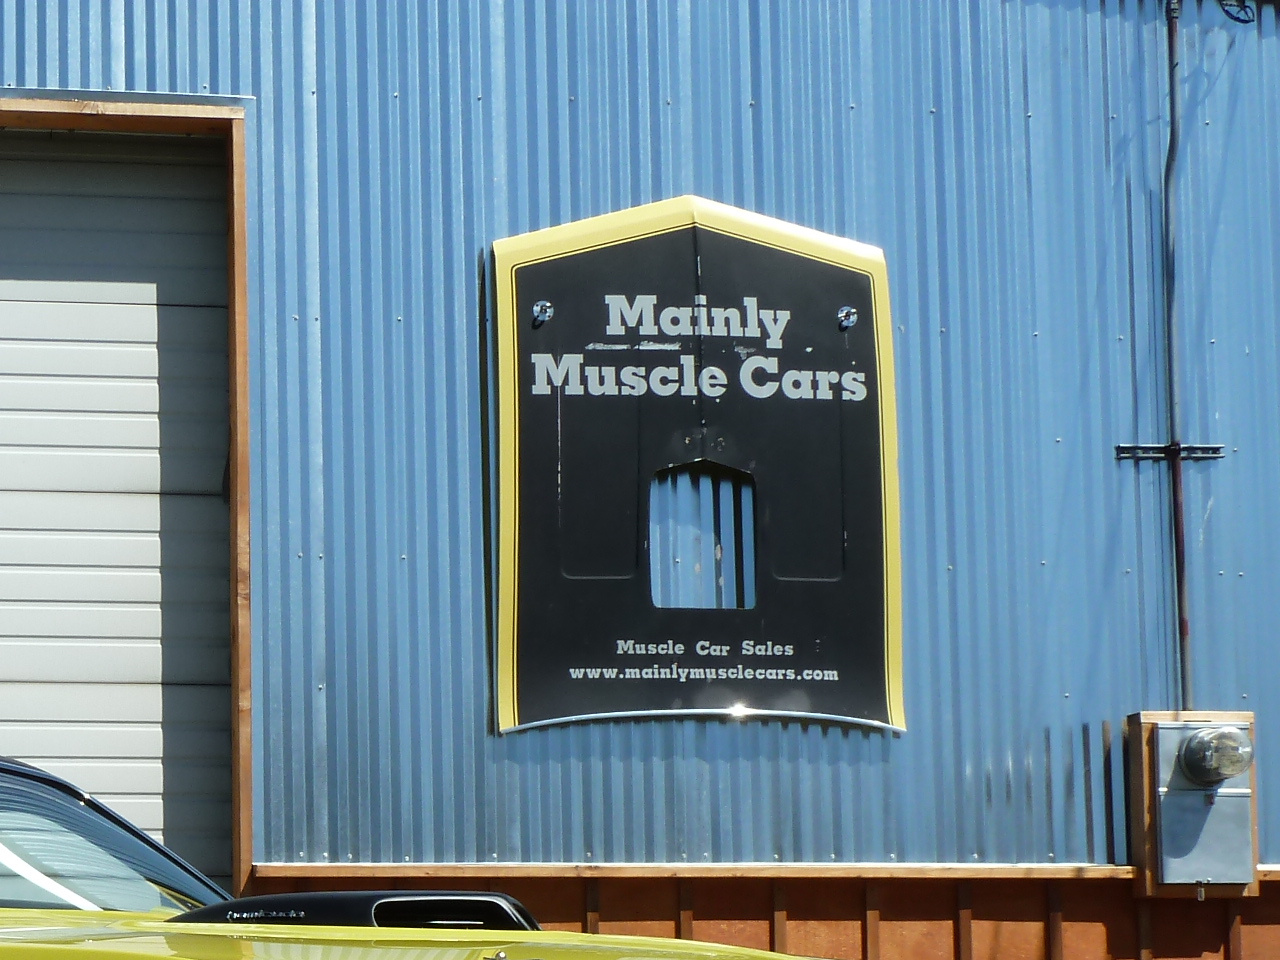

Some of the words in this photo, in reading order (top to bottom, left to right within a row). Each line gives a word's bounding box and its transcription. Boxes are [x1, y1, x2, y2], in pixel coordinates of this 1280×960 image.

[604, 294, 791, 350] Mainly
[531, 353, 728, 398] Muscle
[739, 355, 868, 402] Cars
[616, 638, 685, 656] Muscle
[695, 639, 731, 657] Car
[741, 640, 794, 657] Sales
[569, 662, 839, 683] www.mainlymusclecars.com
